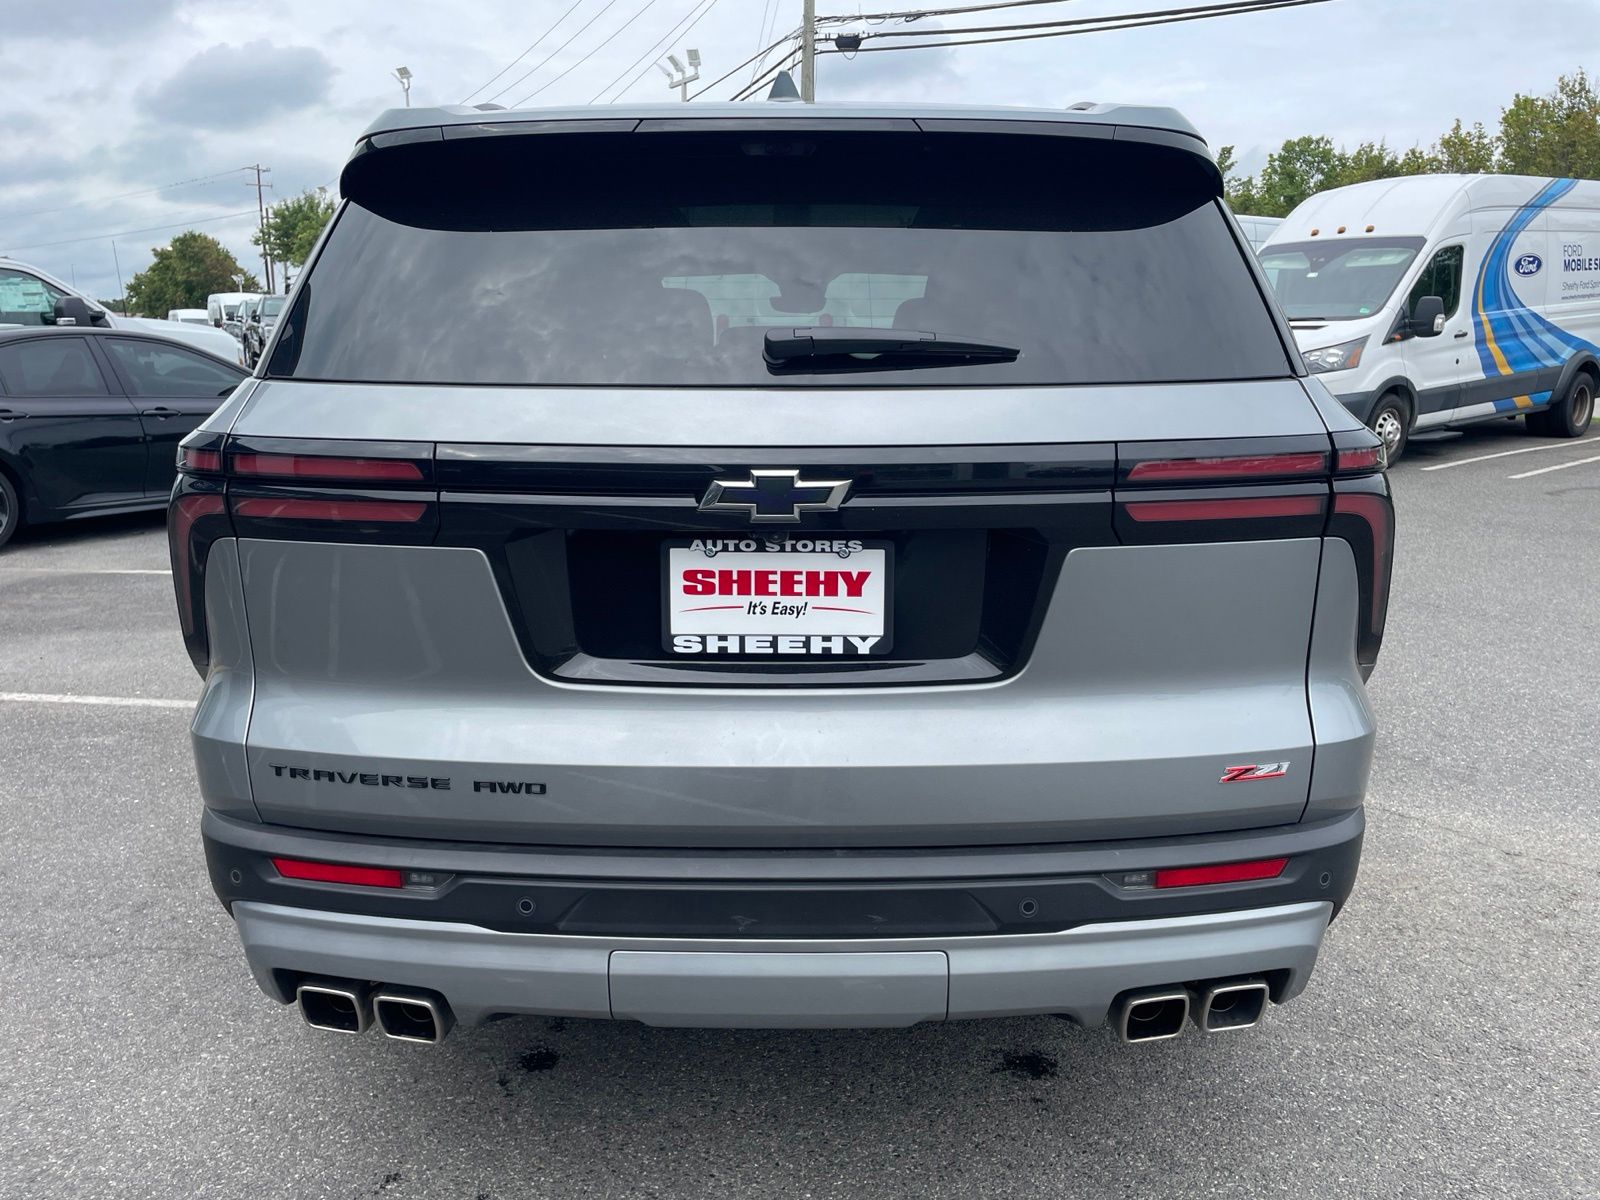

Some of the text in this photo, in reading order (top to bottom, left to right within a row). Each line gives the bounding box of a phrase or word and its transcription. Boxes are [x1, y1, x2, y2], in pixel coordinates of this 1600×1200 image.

[1563, 244, 1582, 257] FORD
[1519, 257, 1538, 274] Ford
[1564, 258, 1593, 272] MOBILE
[689, 539, 863, 553] AUTO STORES
[682, 569, 872, 597] SHEEHY
[747, 601, 808, 619] It's Easy!
[673, 635, 882, 655] SHEEHY
[269, 763, 547, 795] TRAVERSE AWD
[1219, 761, 1291, 782] Z71
